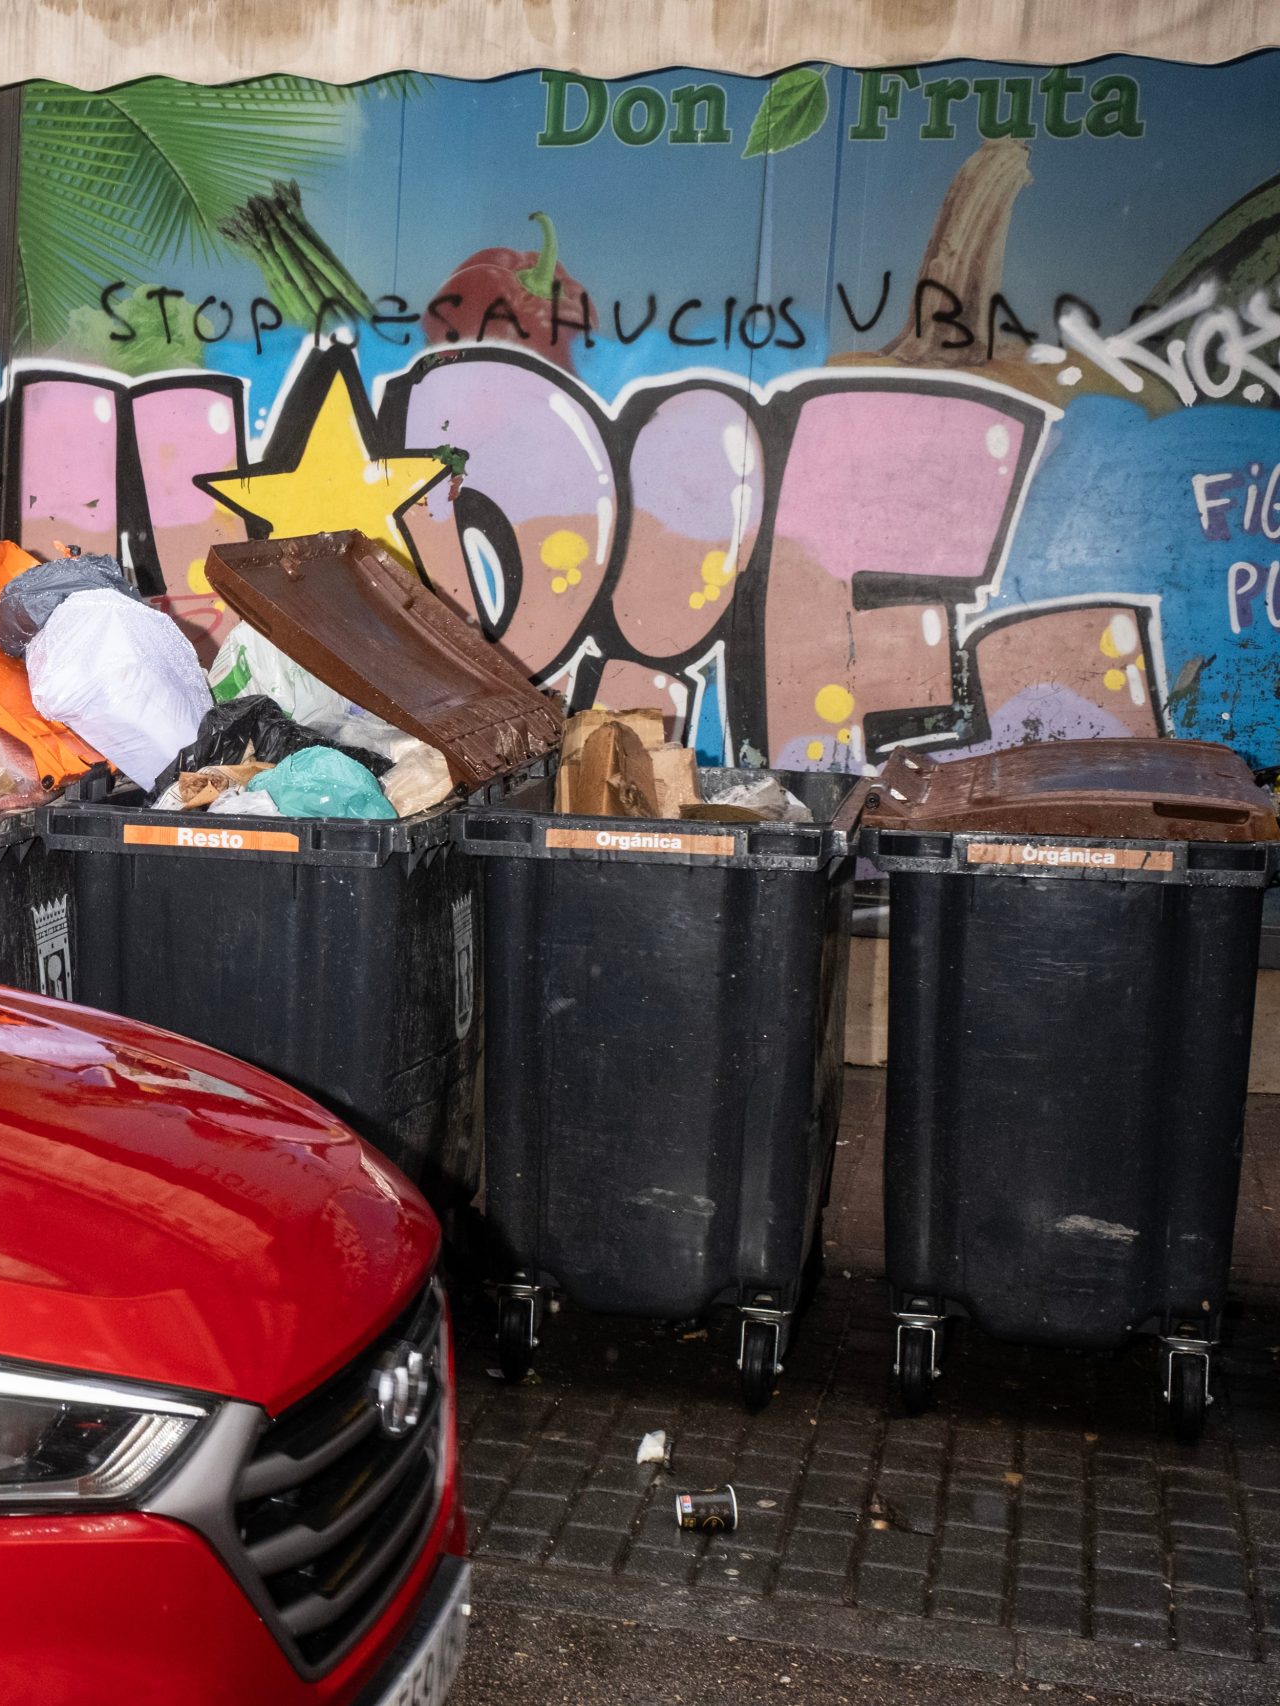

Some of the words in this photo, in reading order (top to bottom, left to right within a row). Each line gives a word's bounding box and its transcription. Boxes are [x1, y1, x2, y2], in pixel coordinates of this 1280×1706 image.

[537, 69, 733, 147] Don
[849, 66, 1146, 142] Fruta
[100, 281, 283, 354] STOP
[177, 827, 244, 849] Resto
[596, 831, 682, 850] Orgánica
[1022, 844, 1115, 866] Orgánica
